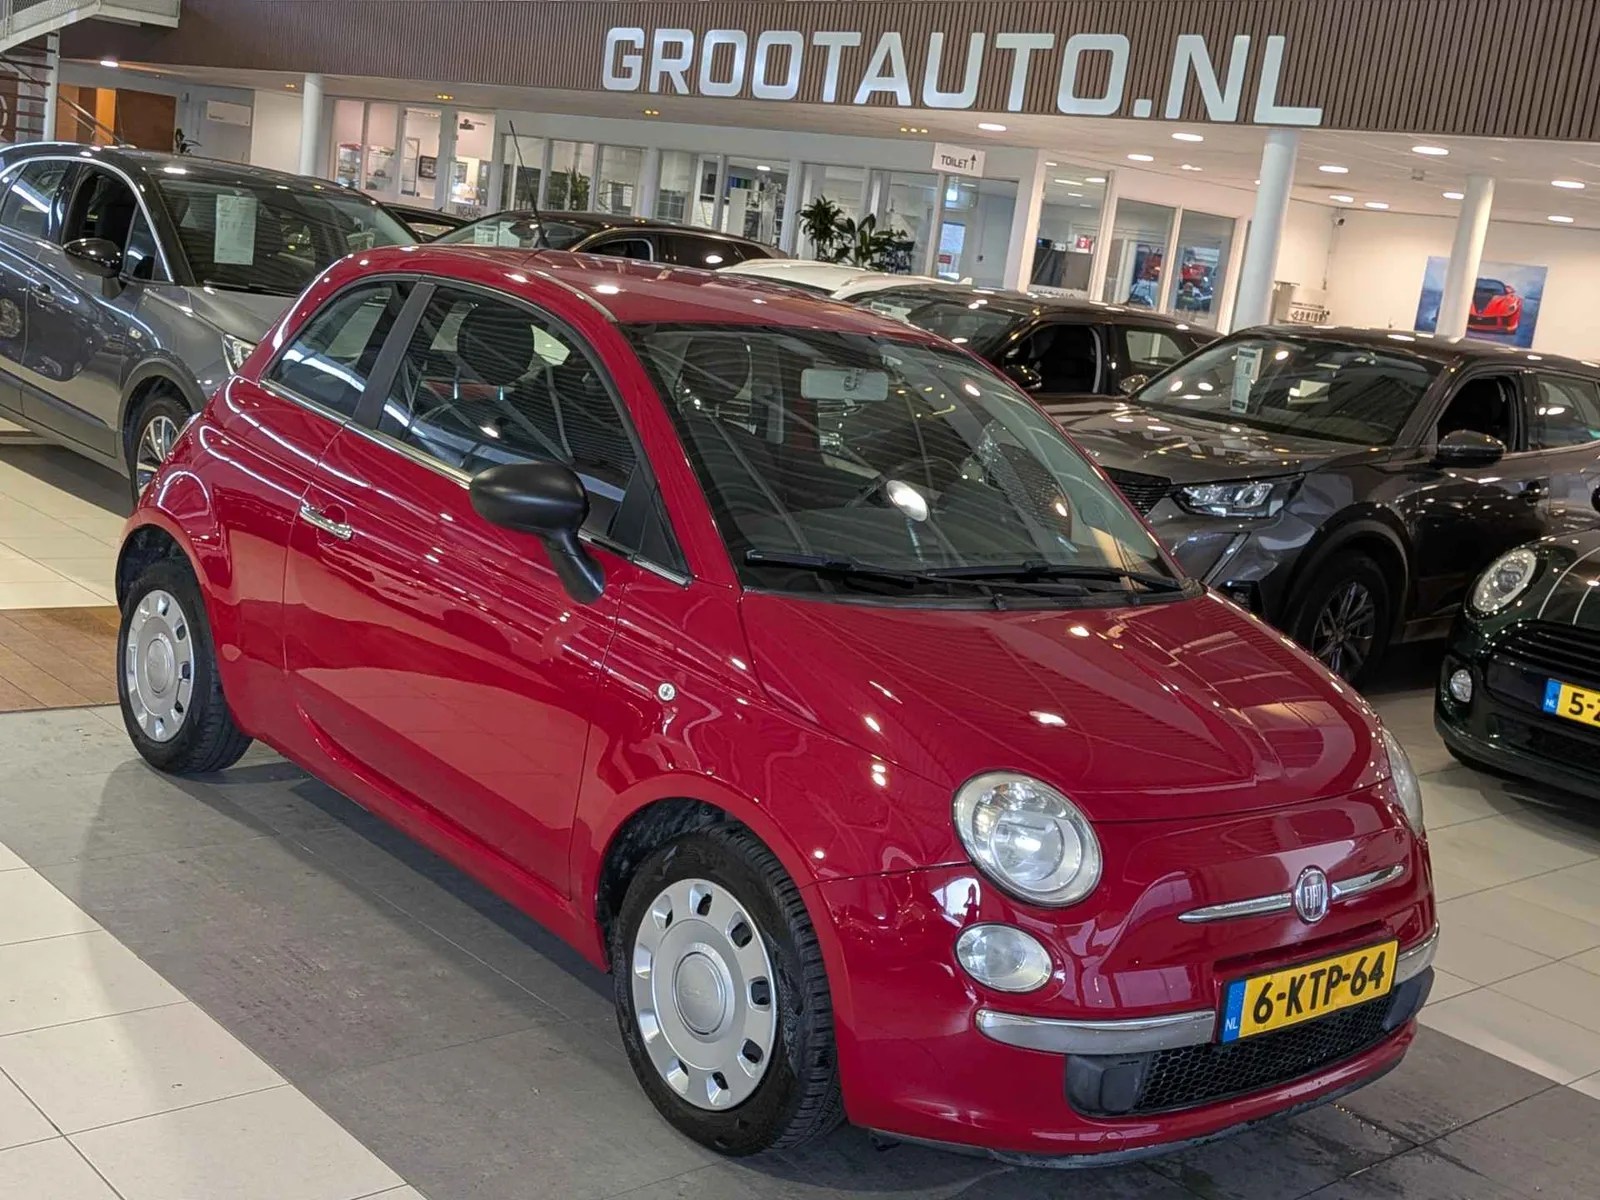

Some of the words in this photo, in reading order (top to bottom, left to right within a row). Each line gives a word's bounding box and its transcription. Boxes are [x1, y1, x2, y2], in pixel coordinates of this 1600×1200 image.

[602, 27, 1323, 126] GROOTAUTO.NL
[941, 154, 969, 169] TOILET
[1304, 883, 1322, 909] FIAT
[1252, 951, 1386, 1025] 6-KTP-64
[1225, 1017, 1239, 1031] NL
